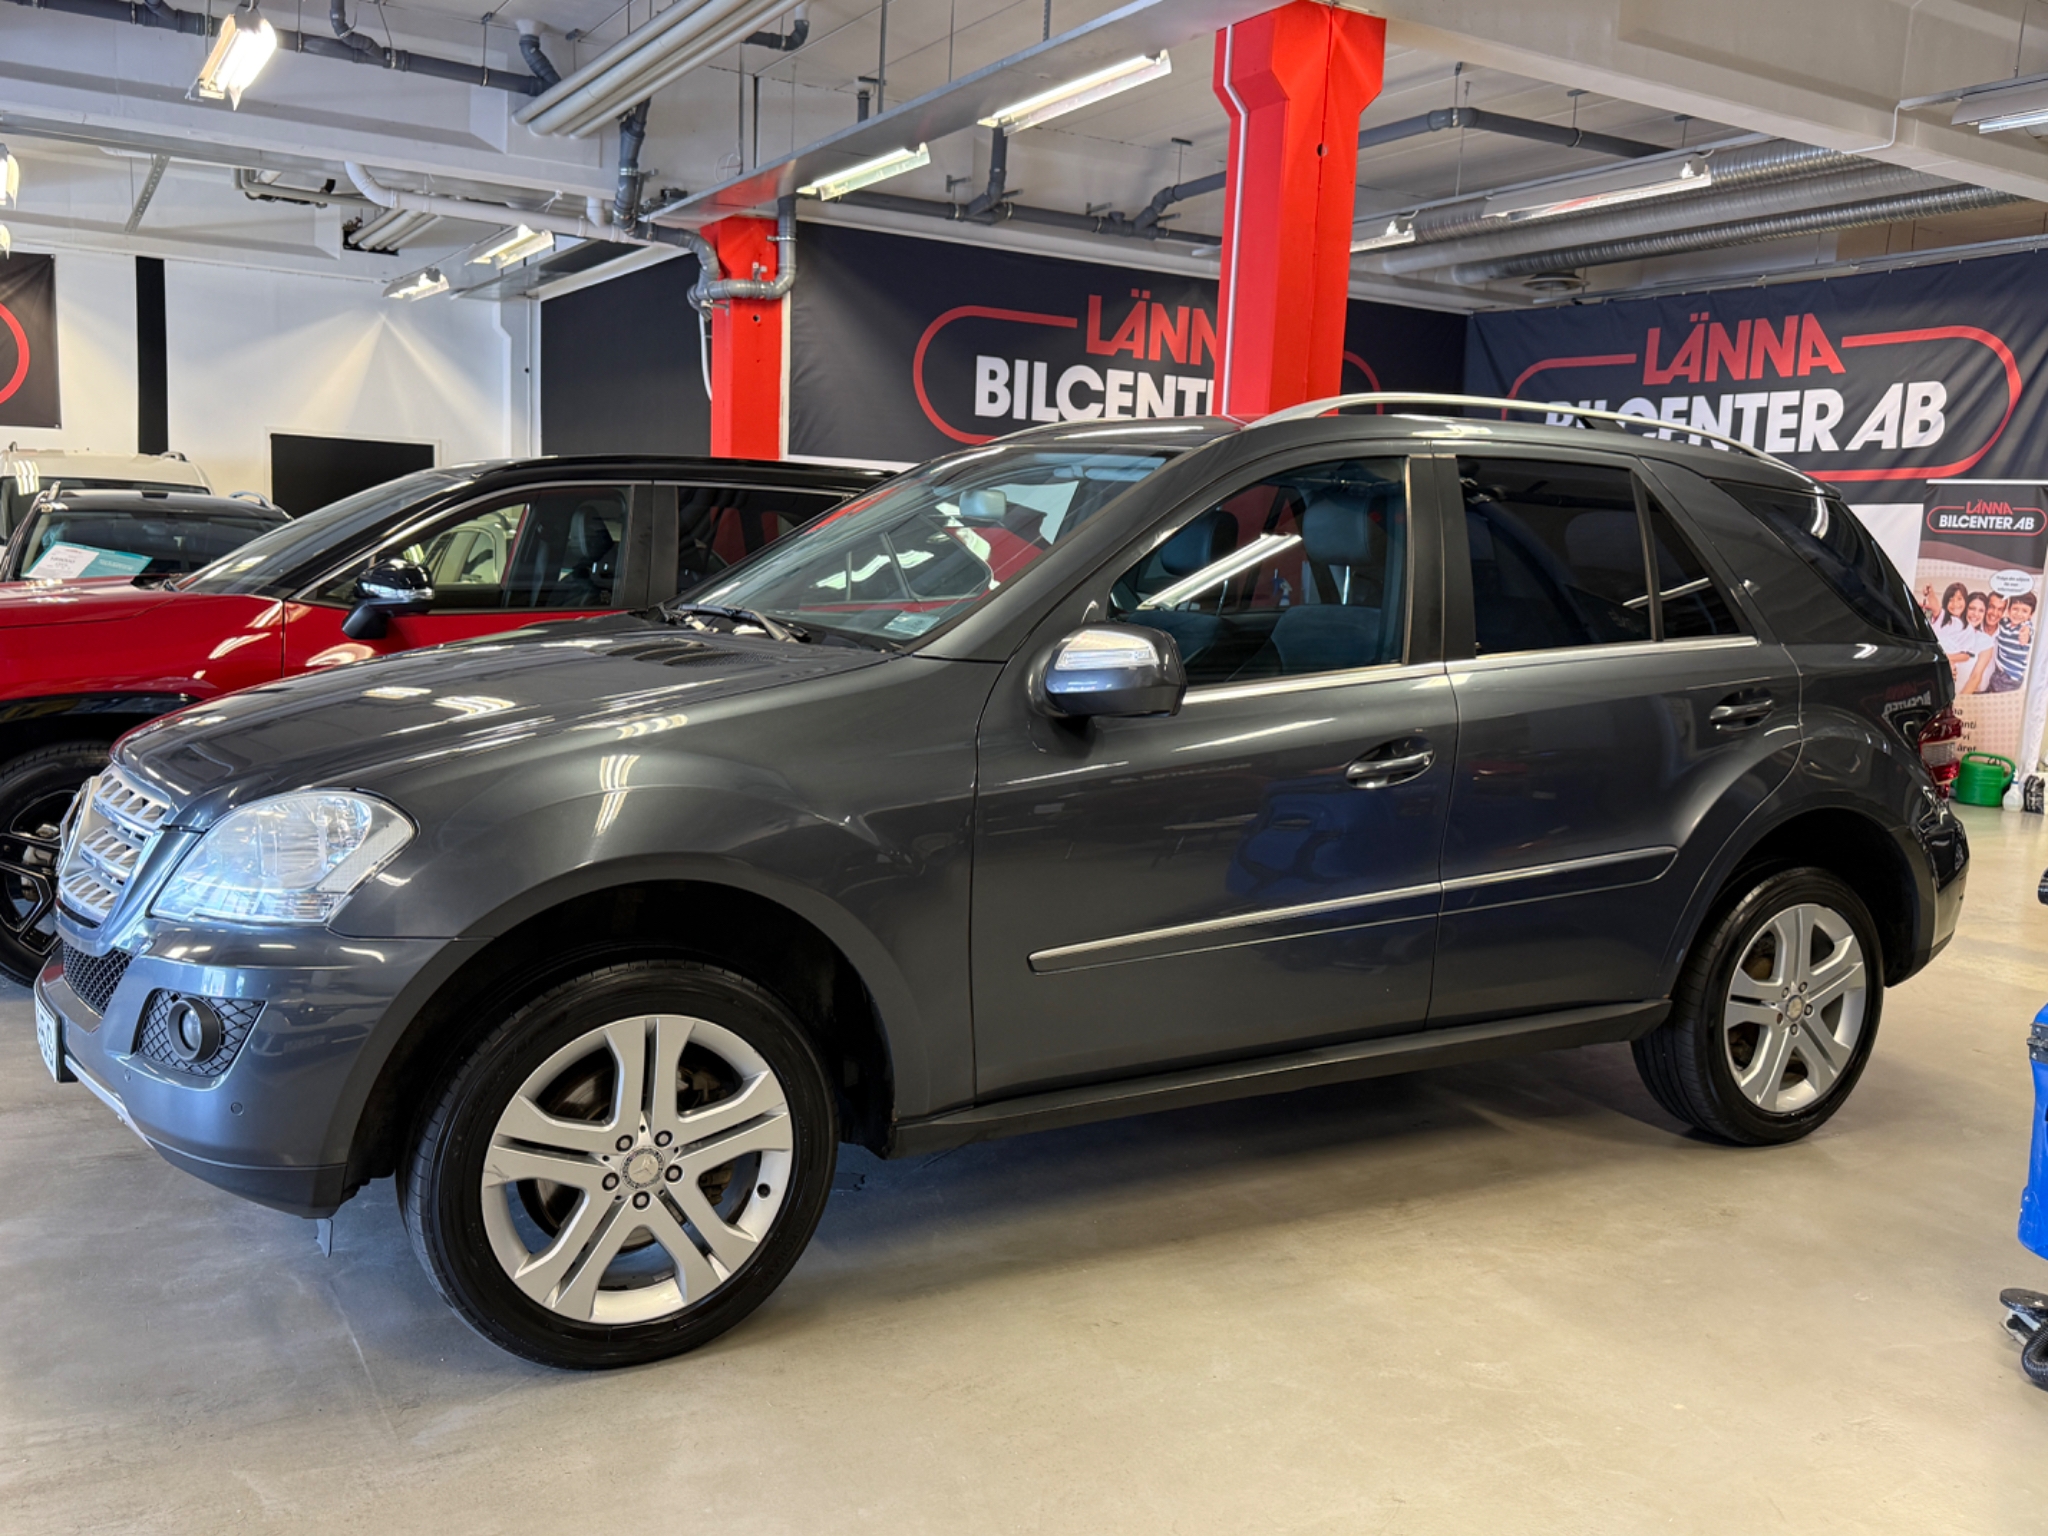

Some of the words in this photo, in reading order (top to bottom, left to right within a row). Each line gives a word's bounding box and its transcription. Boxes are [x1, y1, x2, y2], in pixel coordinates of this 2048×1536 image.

[1643, 312, 1846, 385] LÄNNA
[974, 354, 1214, 422] BILCENT
[1844, 380, 1948, 451] AB
[1938, 514, 2014, 530] BILCENTER
[2013, 516, 2035, 530] AB
[1965, 499, 2014, 515] LÄNNA
